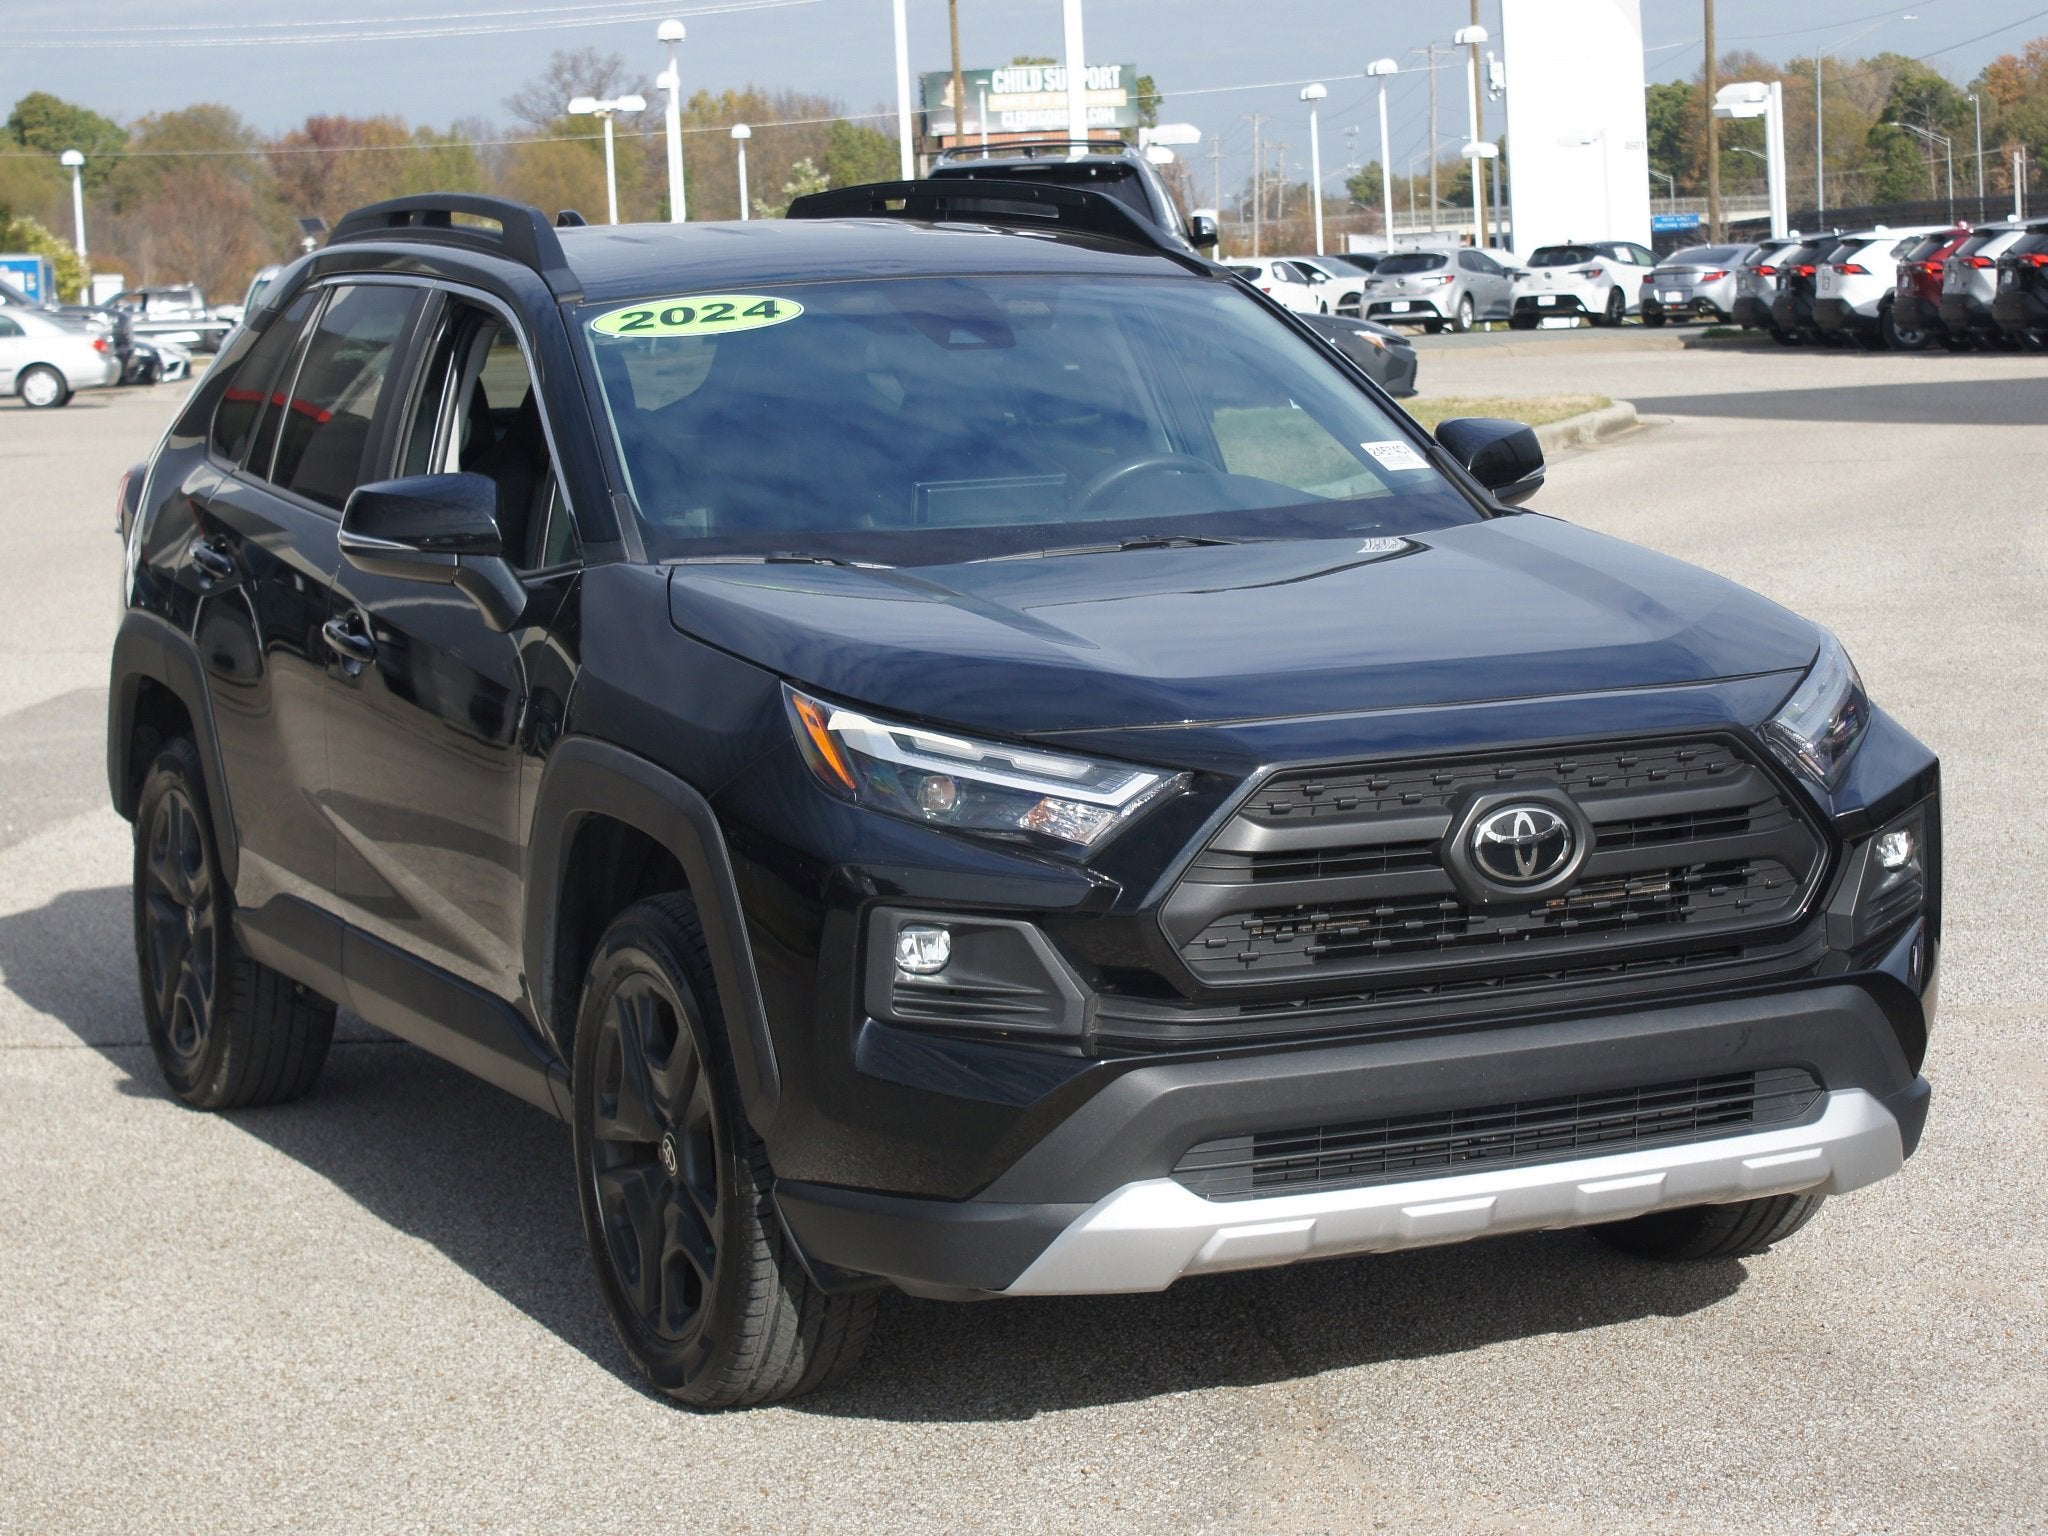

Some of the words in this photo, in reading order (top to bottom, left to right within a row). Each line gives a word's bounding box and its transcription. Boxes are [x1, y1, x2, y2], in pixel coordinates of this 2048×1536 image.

[992, 69, 1042, 93] CHILD
[1044, 66, 1122, 92] SUPORT
[618, 299, 782, 332] 2024
